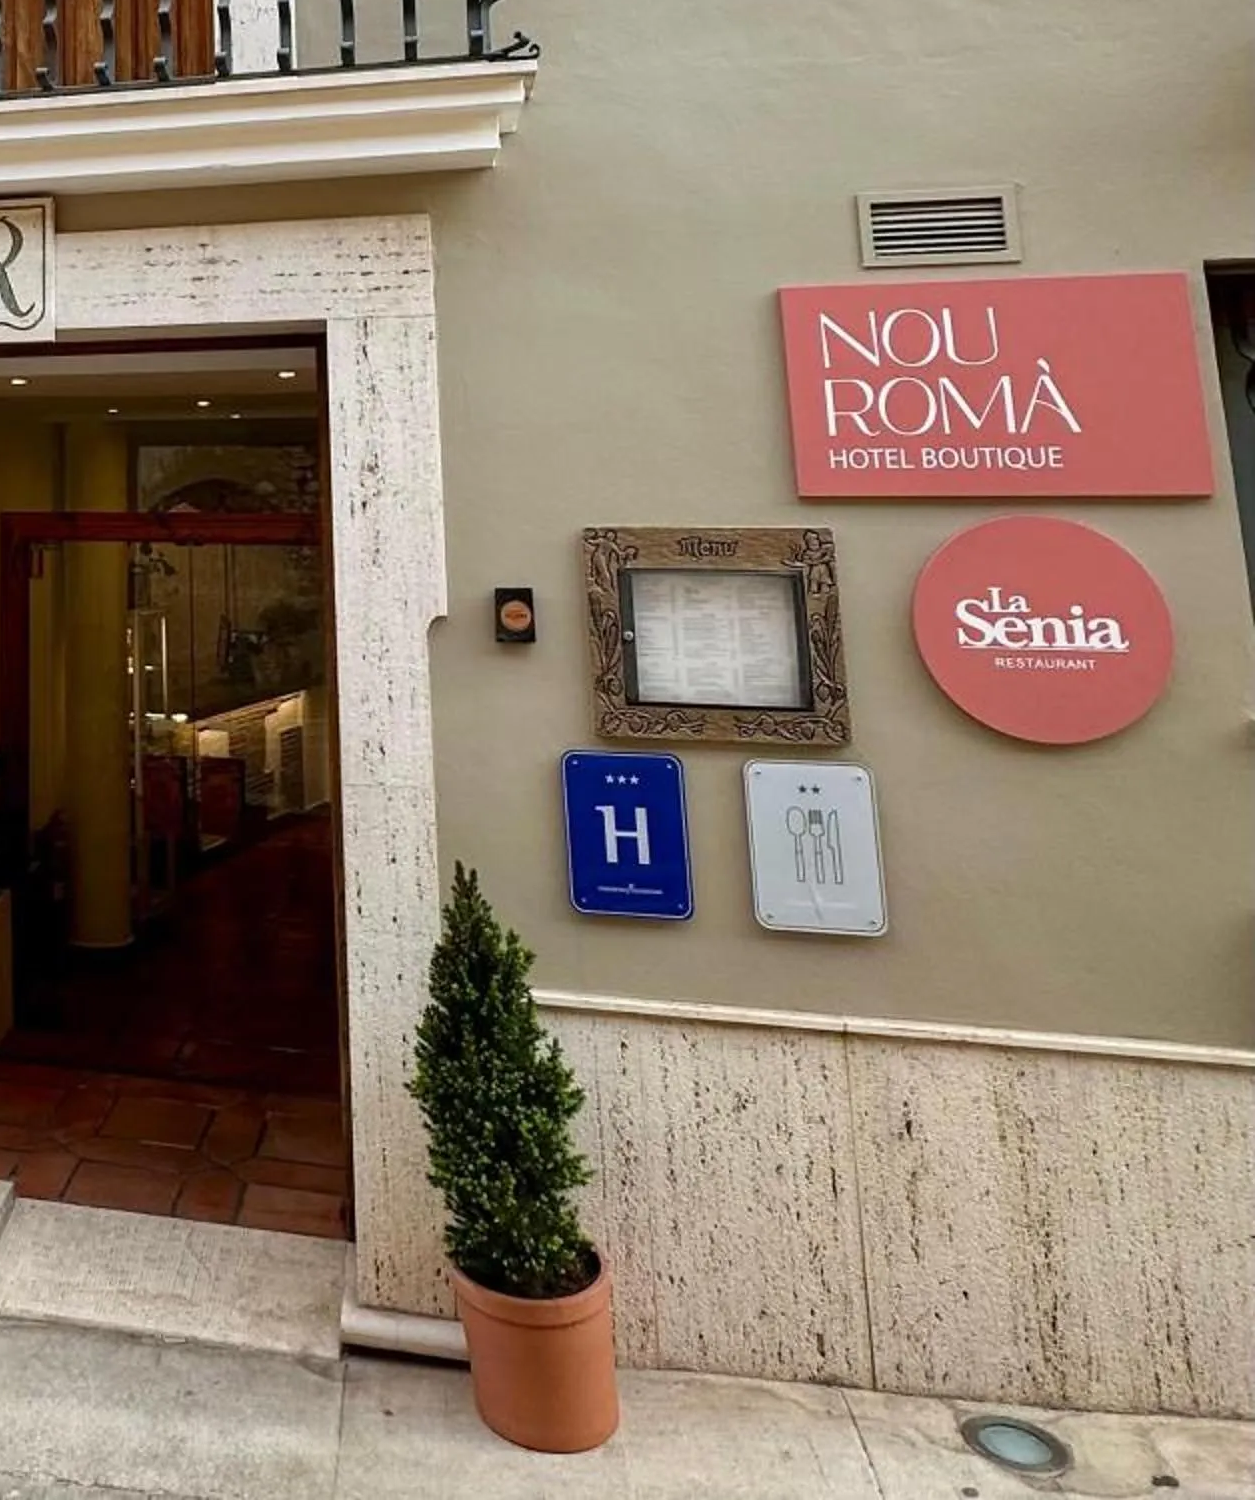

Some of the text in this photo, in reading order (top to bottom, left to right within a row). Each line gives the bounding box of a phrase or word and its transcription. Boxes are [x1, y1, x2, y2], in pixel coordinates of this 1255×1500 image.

[818, 307, 1000, 369] NOU
[823, 357, 1083, 437] ROMÀ
[829, 446, 1064, 470] HOTEL BOUTIQUE
[987, 587, 1031, 613] La
[995, 656, 1097, 670] RESTAURANT
[594, 804, 651, 865] H
